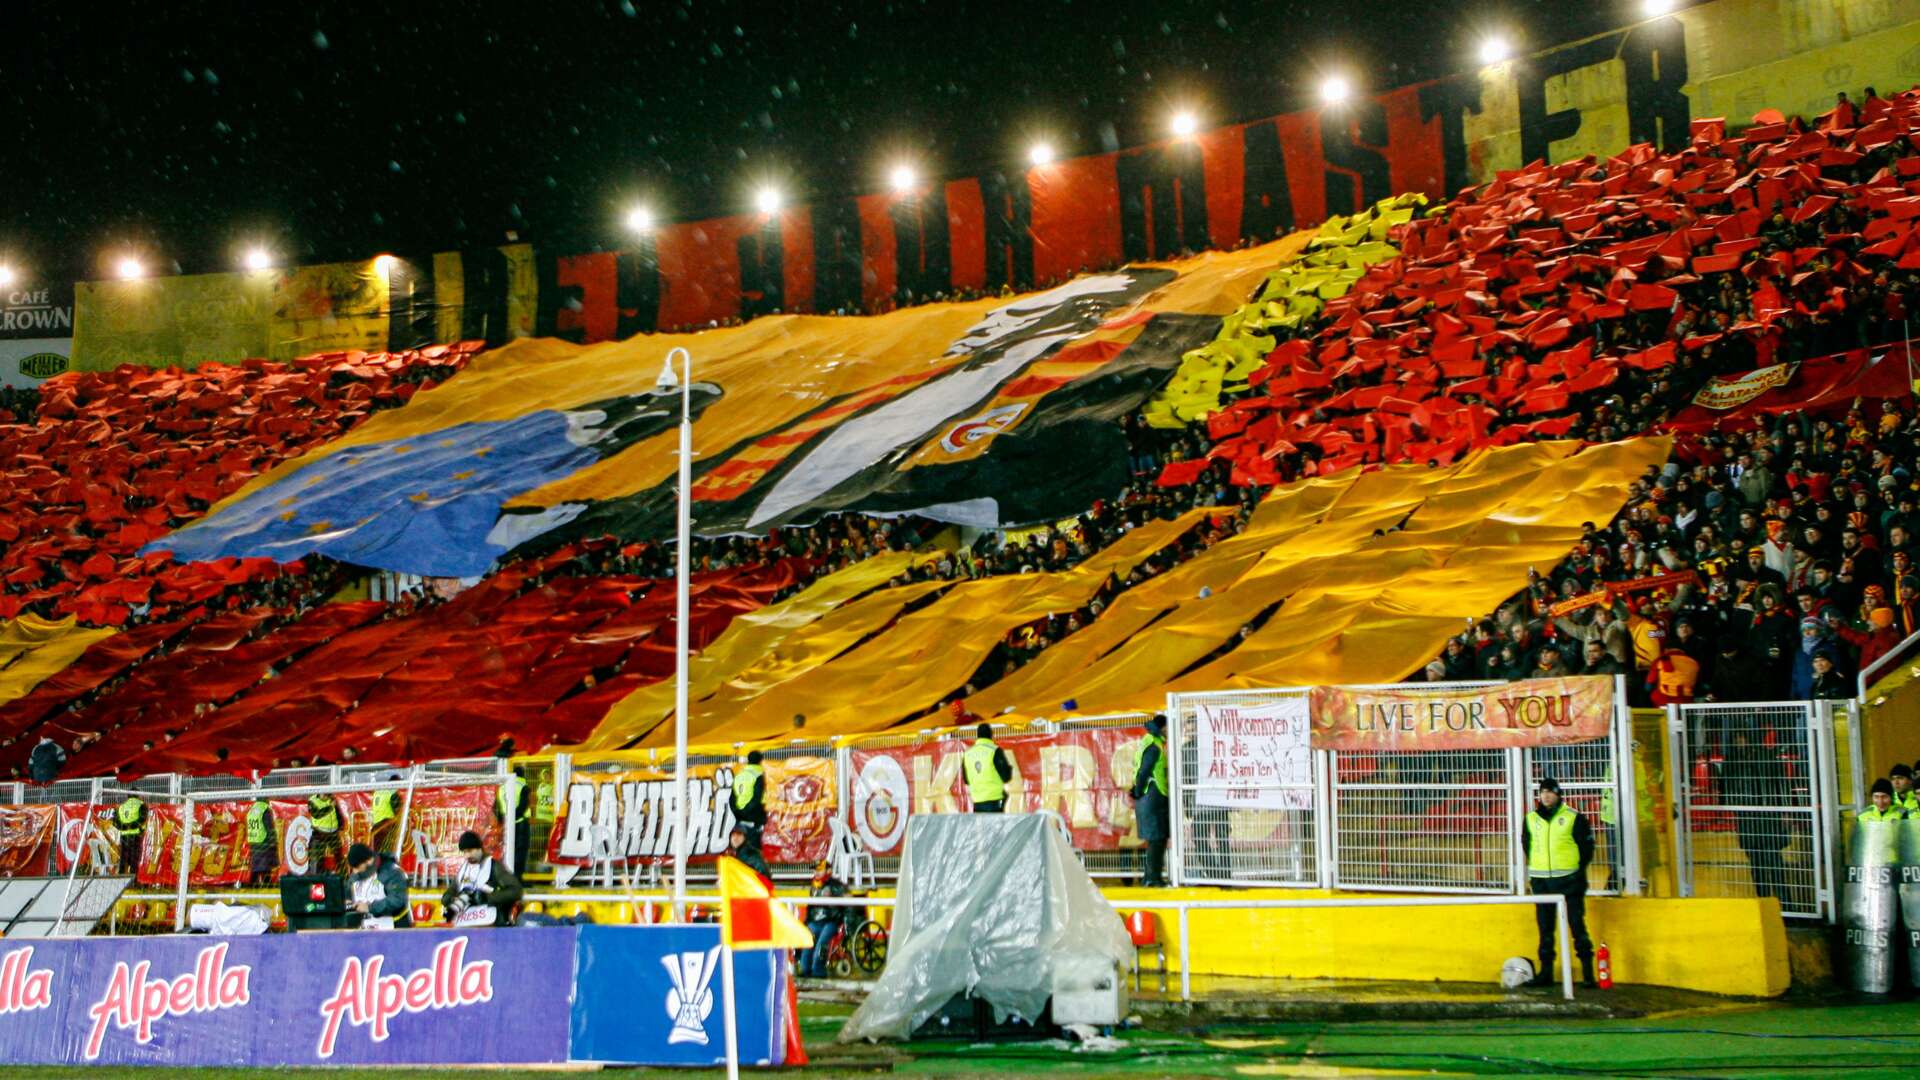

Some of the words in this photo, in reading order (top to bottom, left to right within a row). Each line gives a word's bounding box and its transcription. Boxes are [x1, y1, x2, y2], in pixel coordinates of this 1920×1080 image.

[1117, 17, 1690, 262] MASTER
[9, 288, 49, 305] CAFÉ
[0, 306, 72, 330] ROWN
[1203, 704, 1288, 736] Willkommen
[1356, 702, 1415, 731] LIVE
[1429, 701, 1486, 731] FOR
[1499, 694, 1572, 727] YOU
[1213, 736, 1227, 757] in
[1231, 736, 1250, 757] die
[559, 767, 736, 858] BAKIRKÖ
[1848, 866, 1890, 884] POIS
[1846, 928, 1889, 948] POIS
[85, 942, 251, 1059] Alpella
[318, 936, 494, 1058] Alpella
